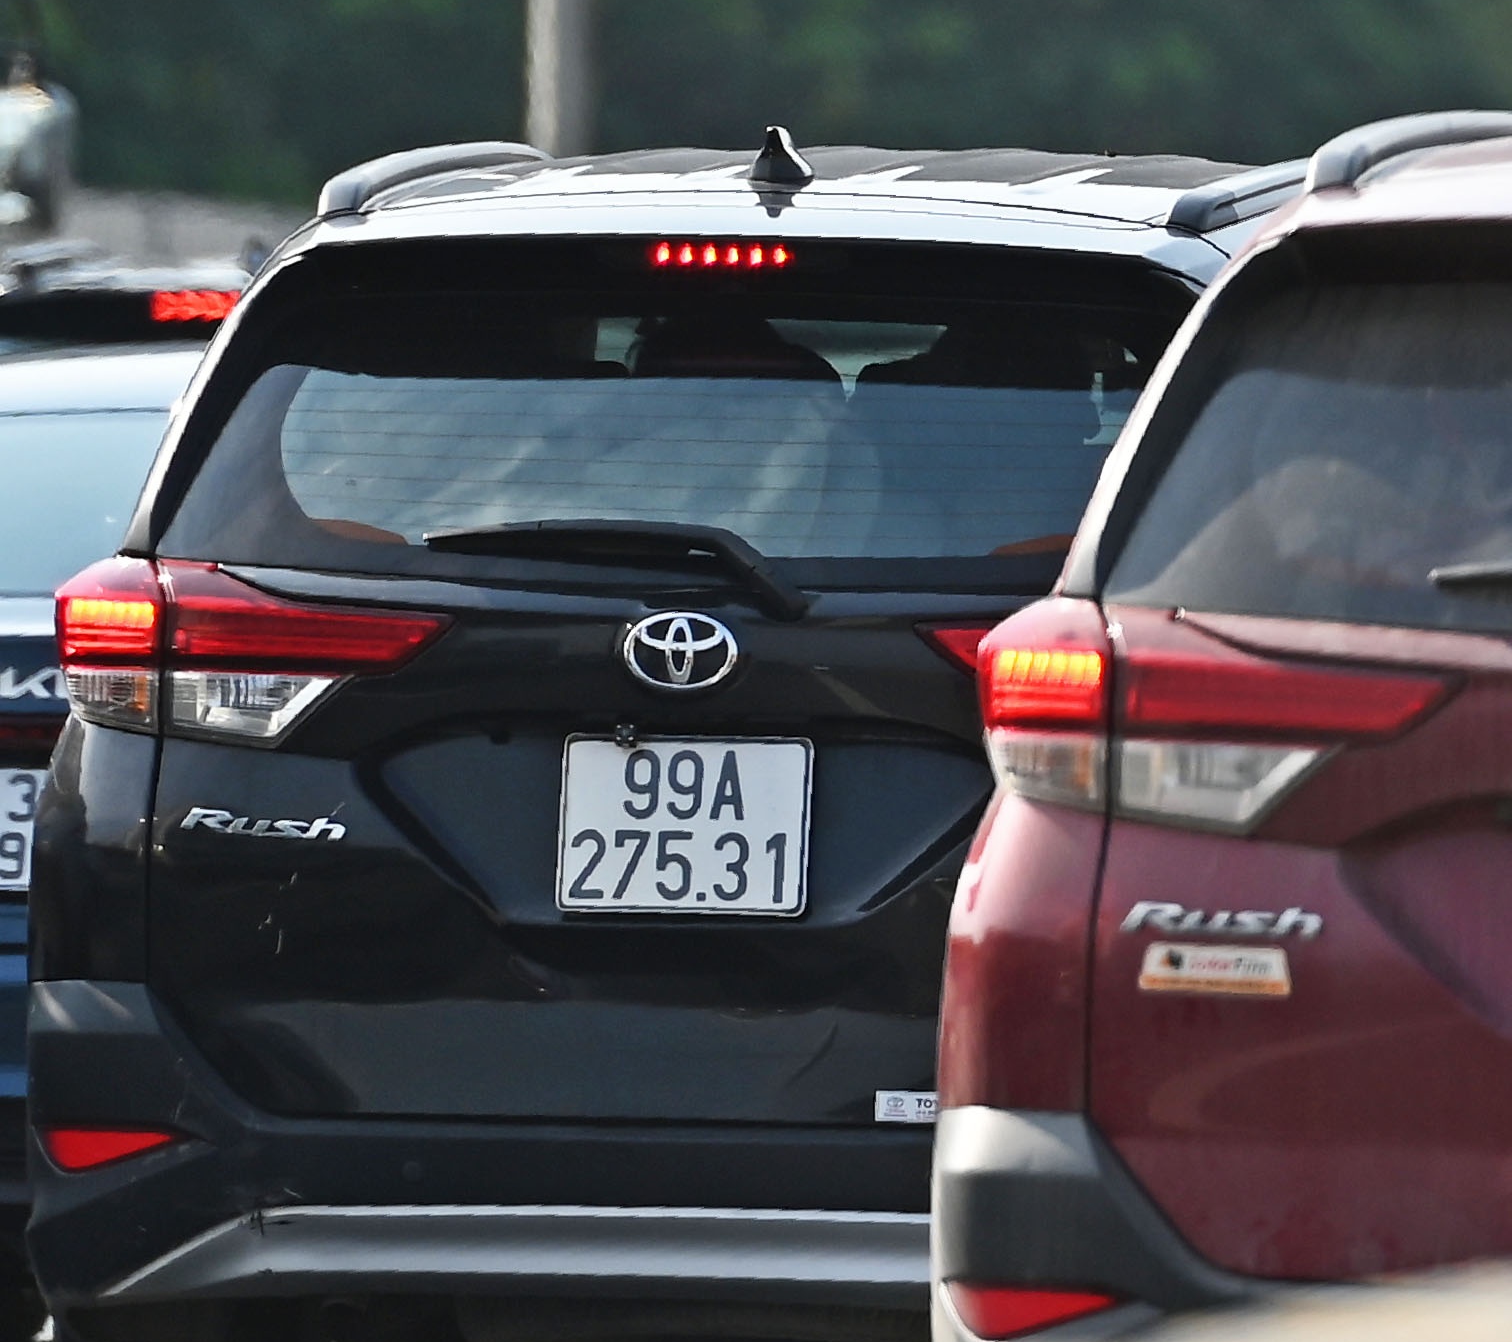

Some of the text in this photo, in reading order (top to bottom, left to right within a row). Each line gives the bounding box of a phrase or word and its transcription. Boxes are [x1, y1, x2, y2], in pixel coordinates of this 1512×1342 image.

[622, 749, 746, 822] 99A
[180, 806, 347, 841] Rush
[569, 828, 787, 905] 275.31
[1119, 899, 1324, 941] Rush
